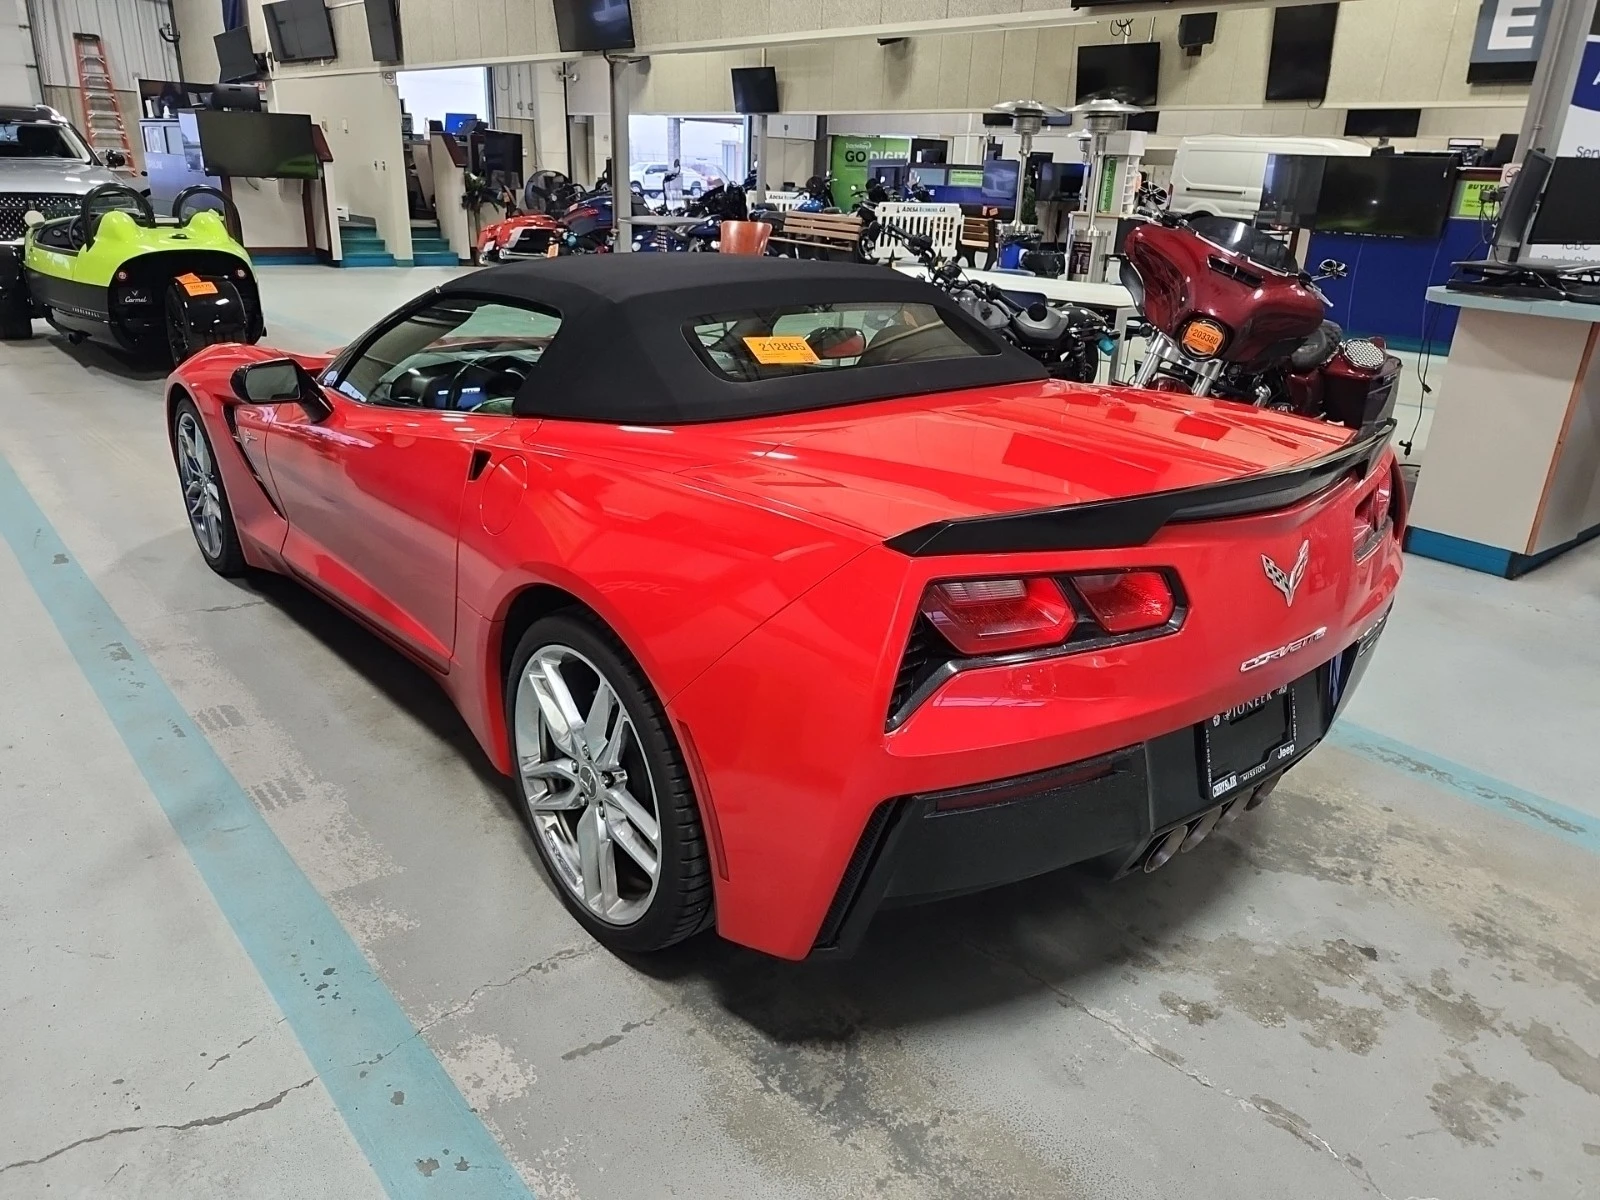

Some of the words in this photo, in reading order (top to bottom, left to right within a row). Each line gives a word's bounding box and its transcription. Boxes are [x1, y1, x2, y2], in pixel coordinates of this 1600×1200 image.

[1487, 0, 1541, 50] E
[845, 151, 867, 163] GO
[125, 295, 147, 304] Carmel
[1192, 328, 1219, 345] 203380
[758, 342, 806, 352] 212865
[1240, 626, 1327, 672] CORVETTE
[1278, 744, 1295, 760] Jeep
[1243, 764, 1266, 781] MISSION
[1212, 774, 1237, 798] CHRYSLER
